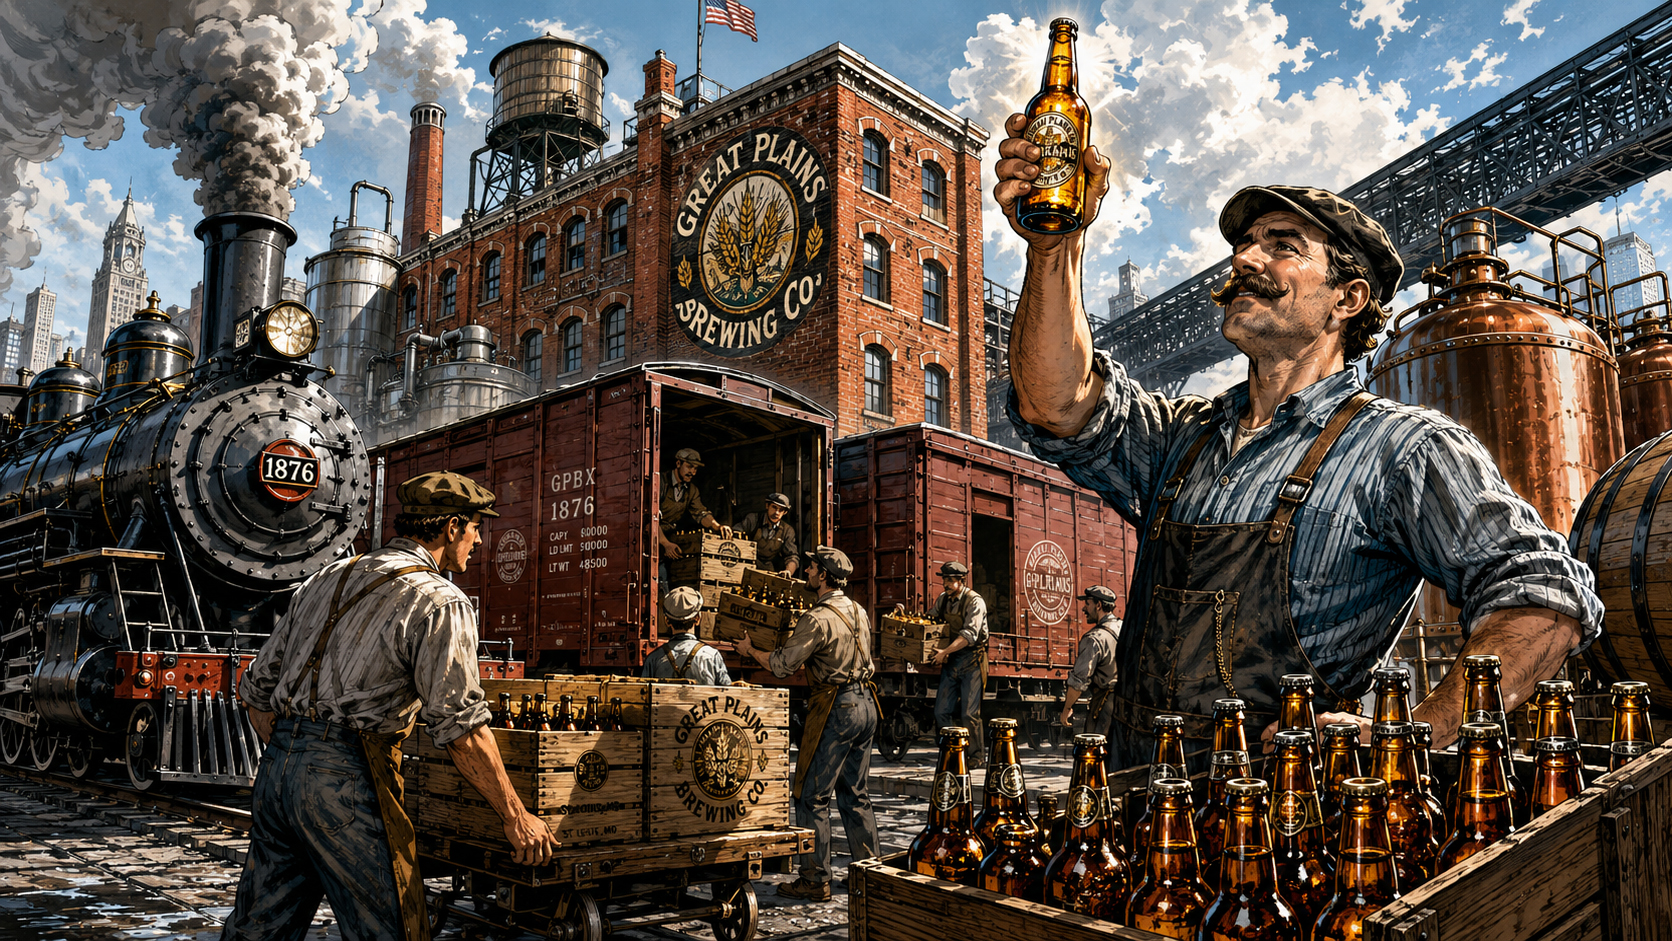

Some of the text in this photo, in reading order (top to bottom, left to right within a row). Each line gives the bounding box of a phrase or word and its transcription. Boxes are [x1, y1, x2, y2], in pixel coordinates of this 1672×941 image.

[676, 132, 826, 237] GREAT PLAINS
[265, 457, 314, 483] 1876
[551, 466, 597, 493] GPBX
[551, 495, 595, 521] 1876
[549, 530, 569, 542] CAPY
[549, 562, 558, 573] LT
[558, 561, 570, 572] WT
[674, 695, 769, 745] GREAT PLAINS
[674, 779, 769, 824] BREWING CO.
